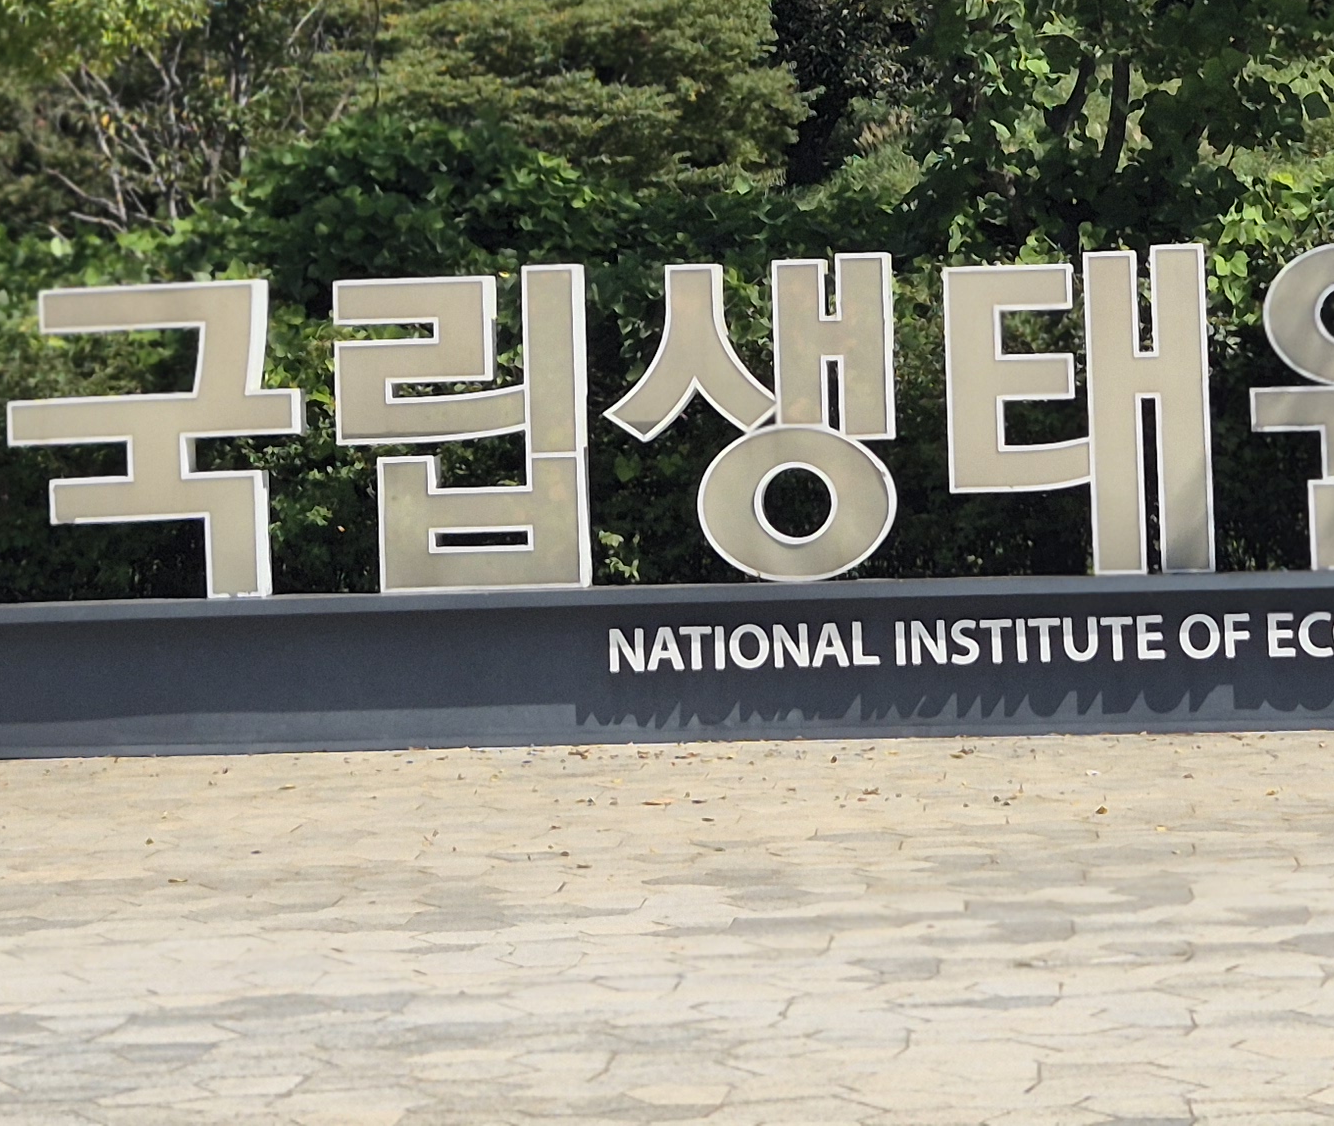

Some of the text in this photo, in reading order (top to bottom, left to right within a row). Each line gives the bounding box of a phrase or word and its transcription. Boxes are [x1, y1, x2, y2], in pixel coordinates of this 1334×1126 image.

[608, 620, 880, 673] NATIONAL
[895, 615, 1167, 666] INSTITUTE
[1178, 612, 1251, 660] OF
